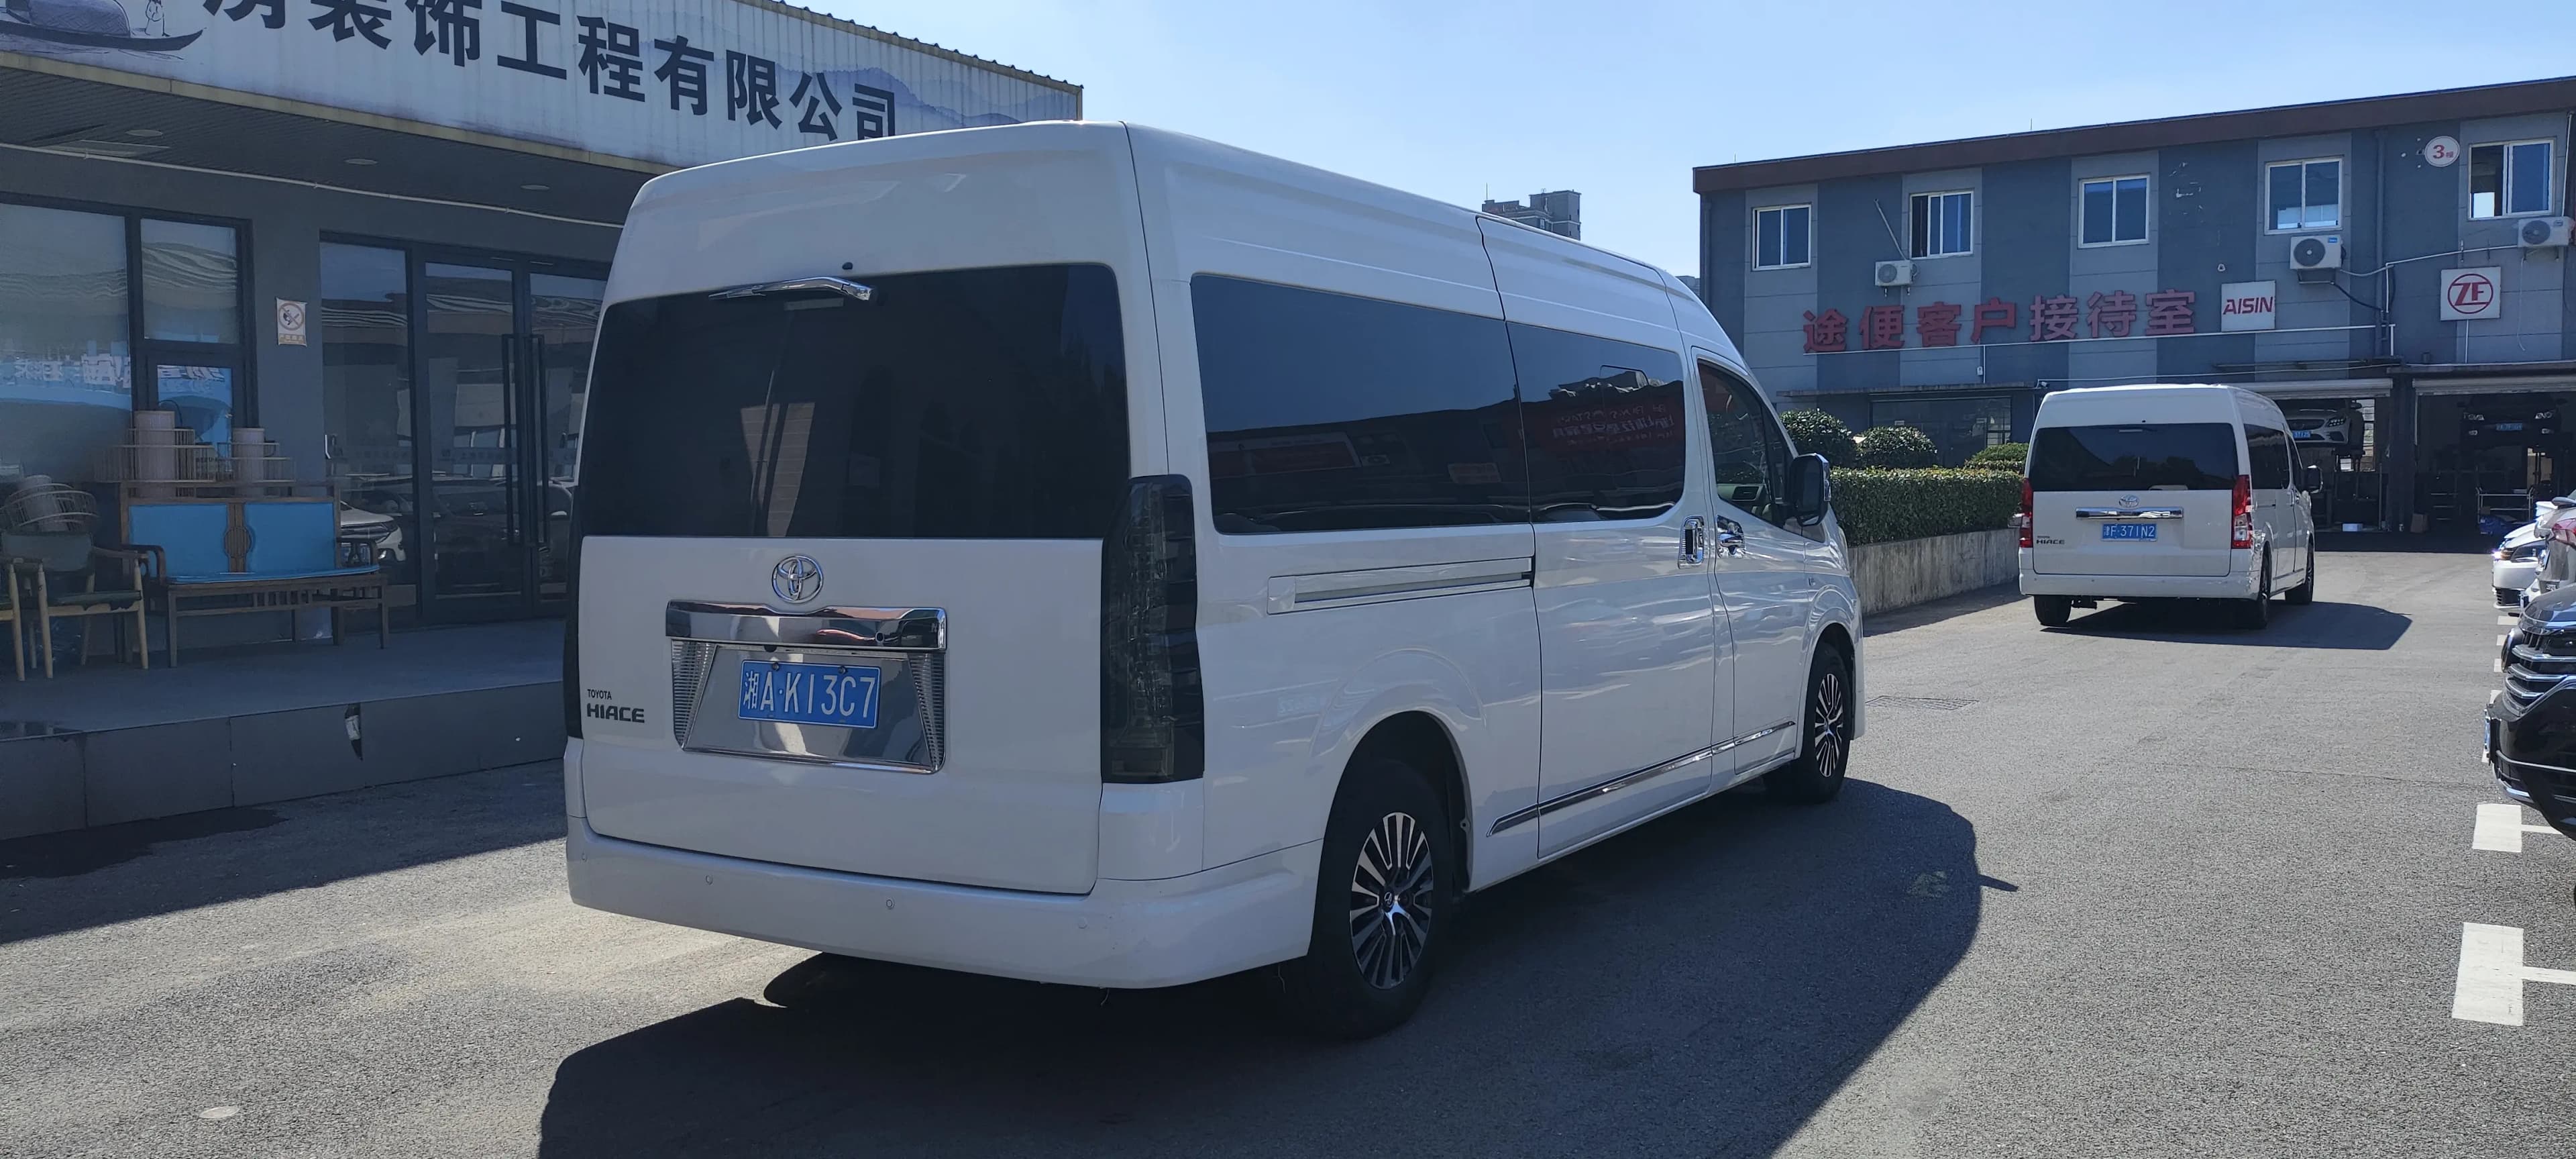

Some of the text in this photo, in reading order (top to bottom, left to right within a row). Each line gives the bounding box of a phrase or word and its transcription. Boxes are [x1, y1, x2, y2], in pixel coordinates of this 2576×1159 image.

[2450, 281, 2491, 307] ZF
[2222, 297, 2273, 315] AISIN
[1803, 289, 2196, 353] 途便客户接待室
[587, 689, 612, 700] TOYOTA
[587, 703, 645, 723] HIACE
